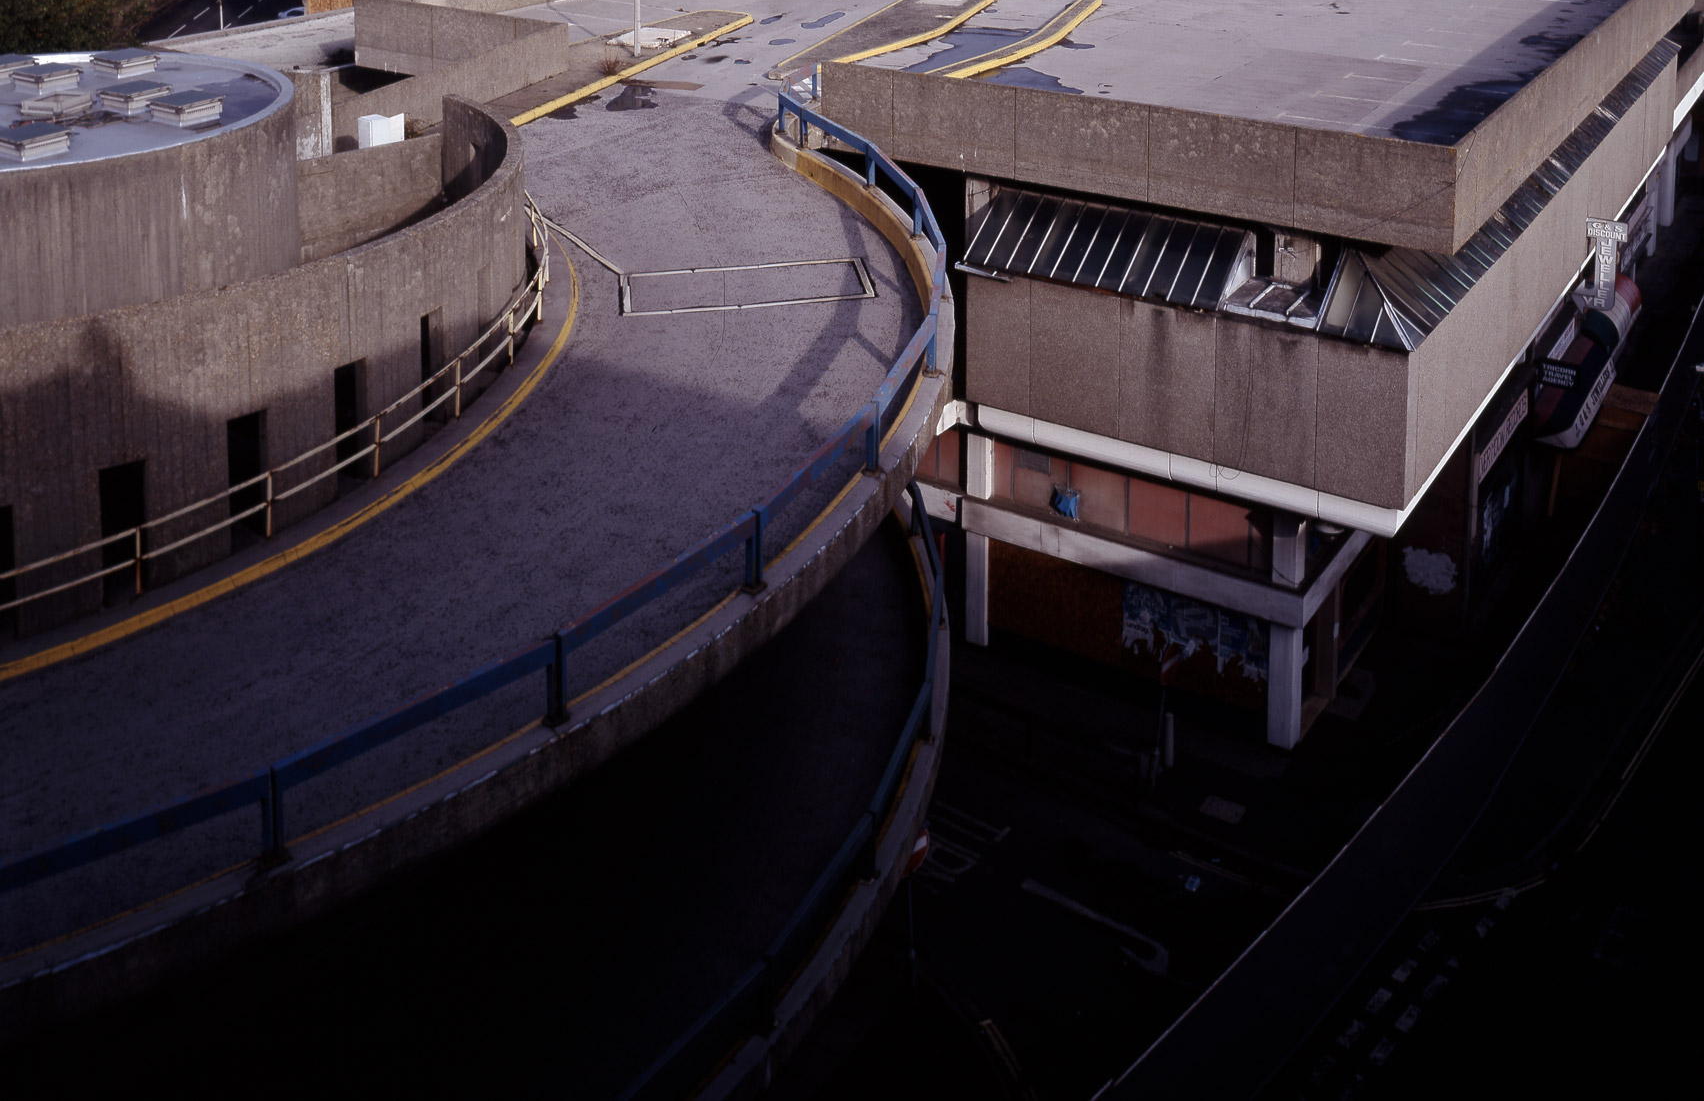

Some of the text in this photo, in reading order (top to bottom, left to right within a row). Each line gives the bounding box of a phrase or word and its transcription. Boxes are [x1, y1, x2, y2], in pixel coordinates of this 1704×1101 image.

[1592, 222, 1623, 233] G & S
[1587, 228, 1627, 241] DISCOUNT
[1542, 362, 1577, 377] TRICORN
[1544, 369, 1574, 382] TRAVEL
[1542, 376, 1574, 388] AGENCY
